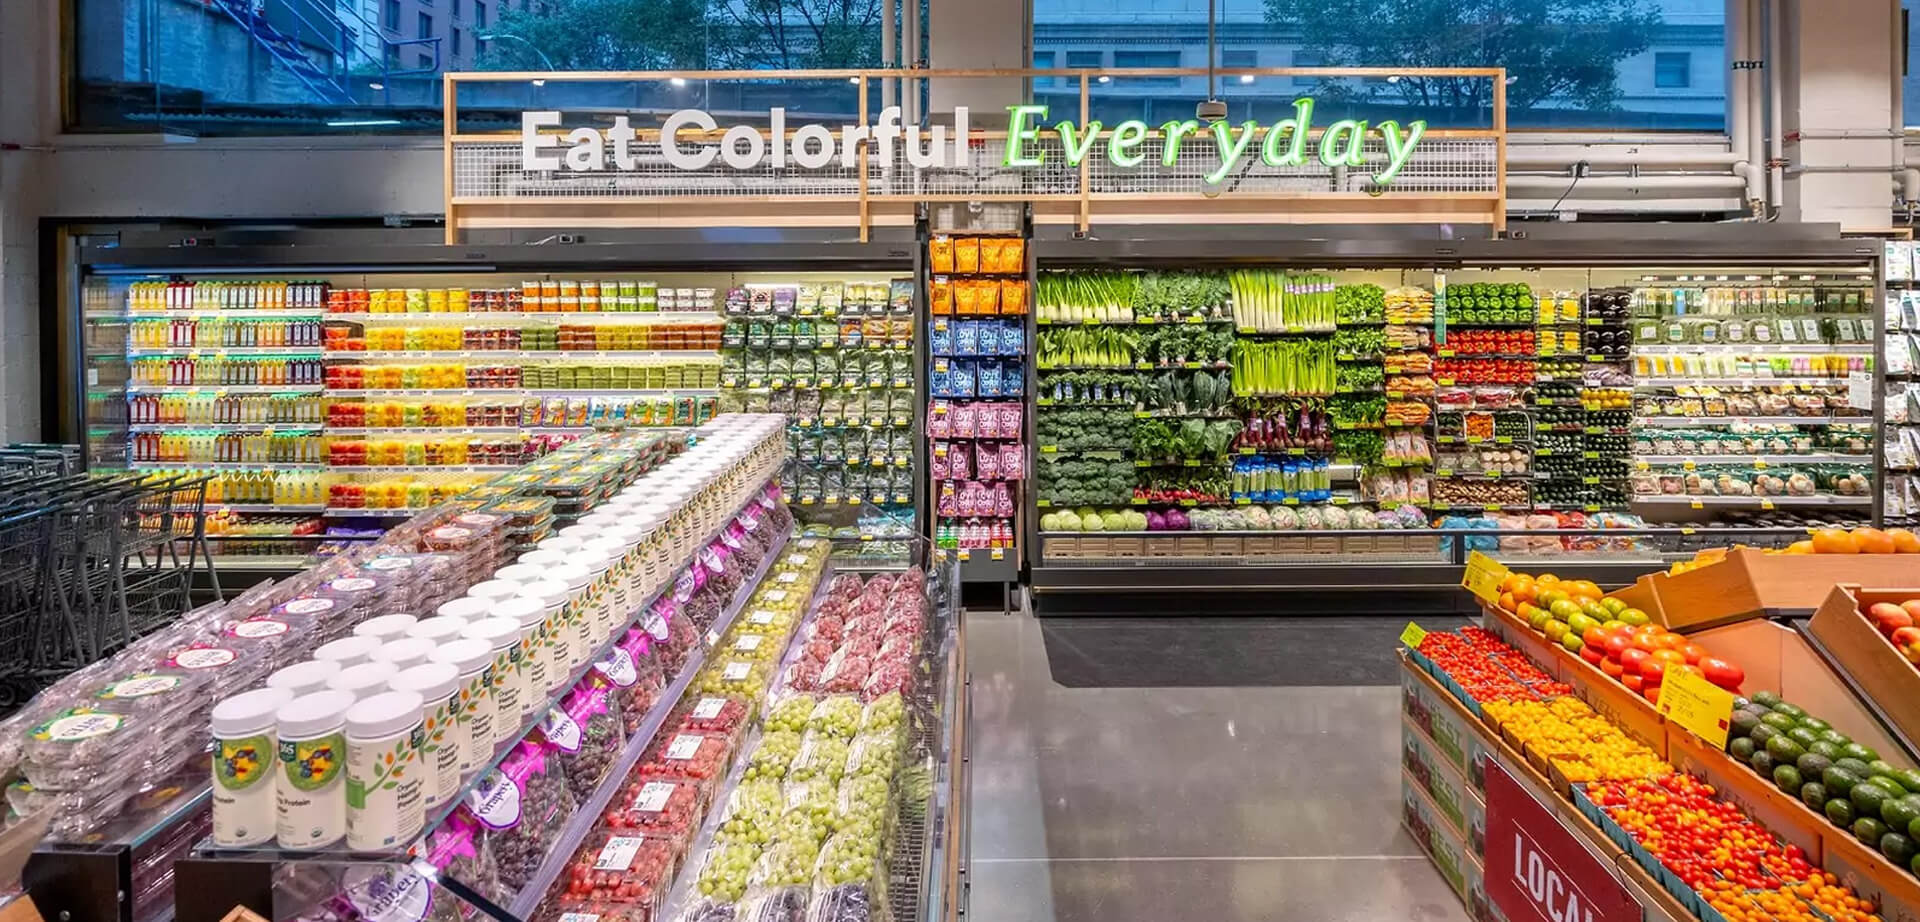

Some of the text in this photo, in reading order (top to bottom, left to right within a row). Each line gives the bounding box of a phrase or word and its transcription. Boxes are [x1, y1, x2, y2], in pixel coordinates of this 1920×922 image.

[522, 98, 1427, 185] Eat Colorful Everyday
